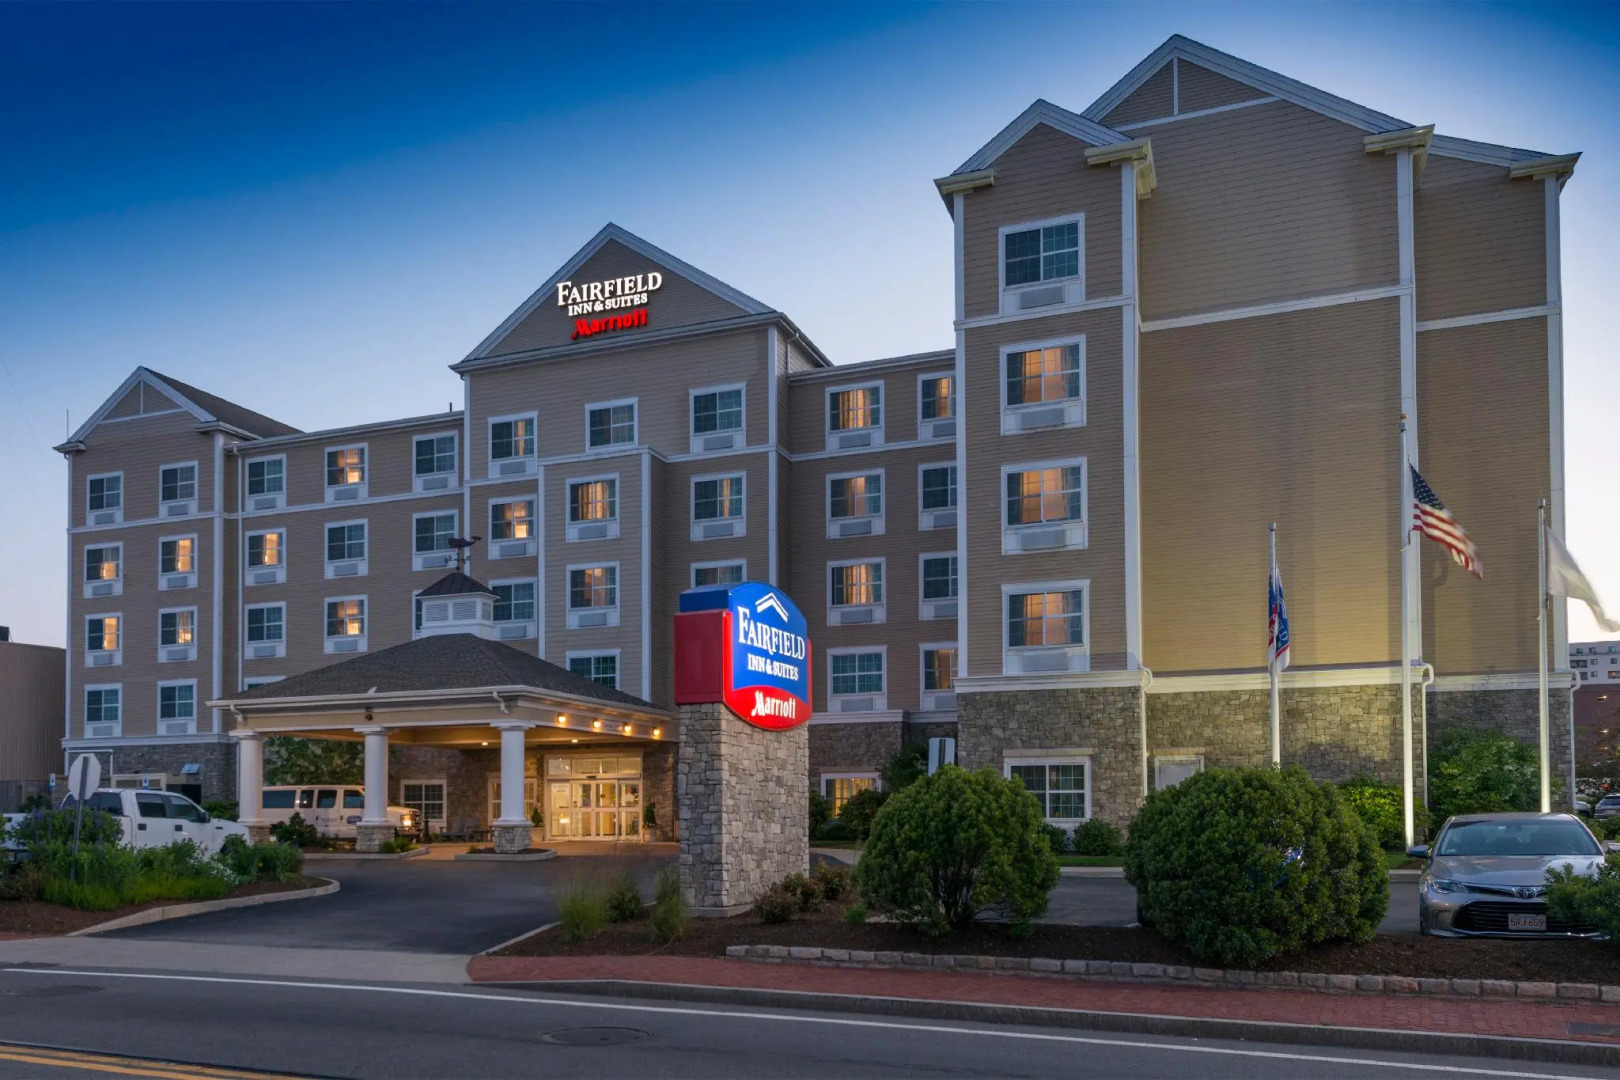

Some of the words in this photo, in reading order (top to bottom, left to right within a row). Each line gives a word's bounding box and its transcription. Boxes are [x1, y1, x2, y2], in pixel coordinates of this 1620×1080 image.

[556, 272, 662, 306] FAIRFIELD
[568, 303, 592, 316] INN
[604, 293, 648, 310] SUITES
[571, 308, 648, 340] Marriott
[737, 606, 805, 660] FAIRFIELD
[747, 653, 765, 673] INN
[773, 661, 799, 681] SUITES
[751, 690, 796, 719] Marriott
